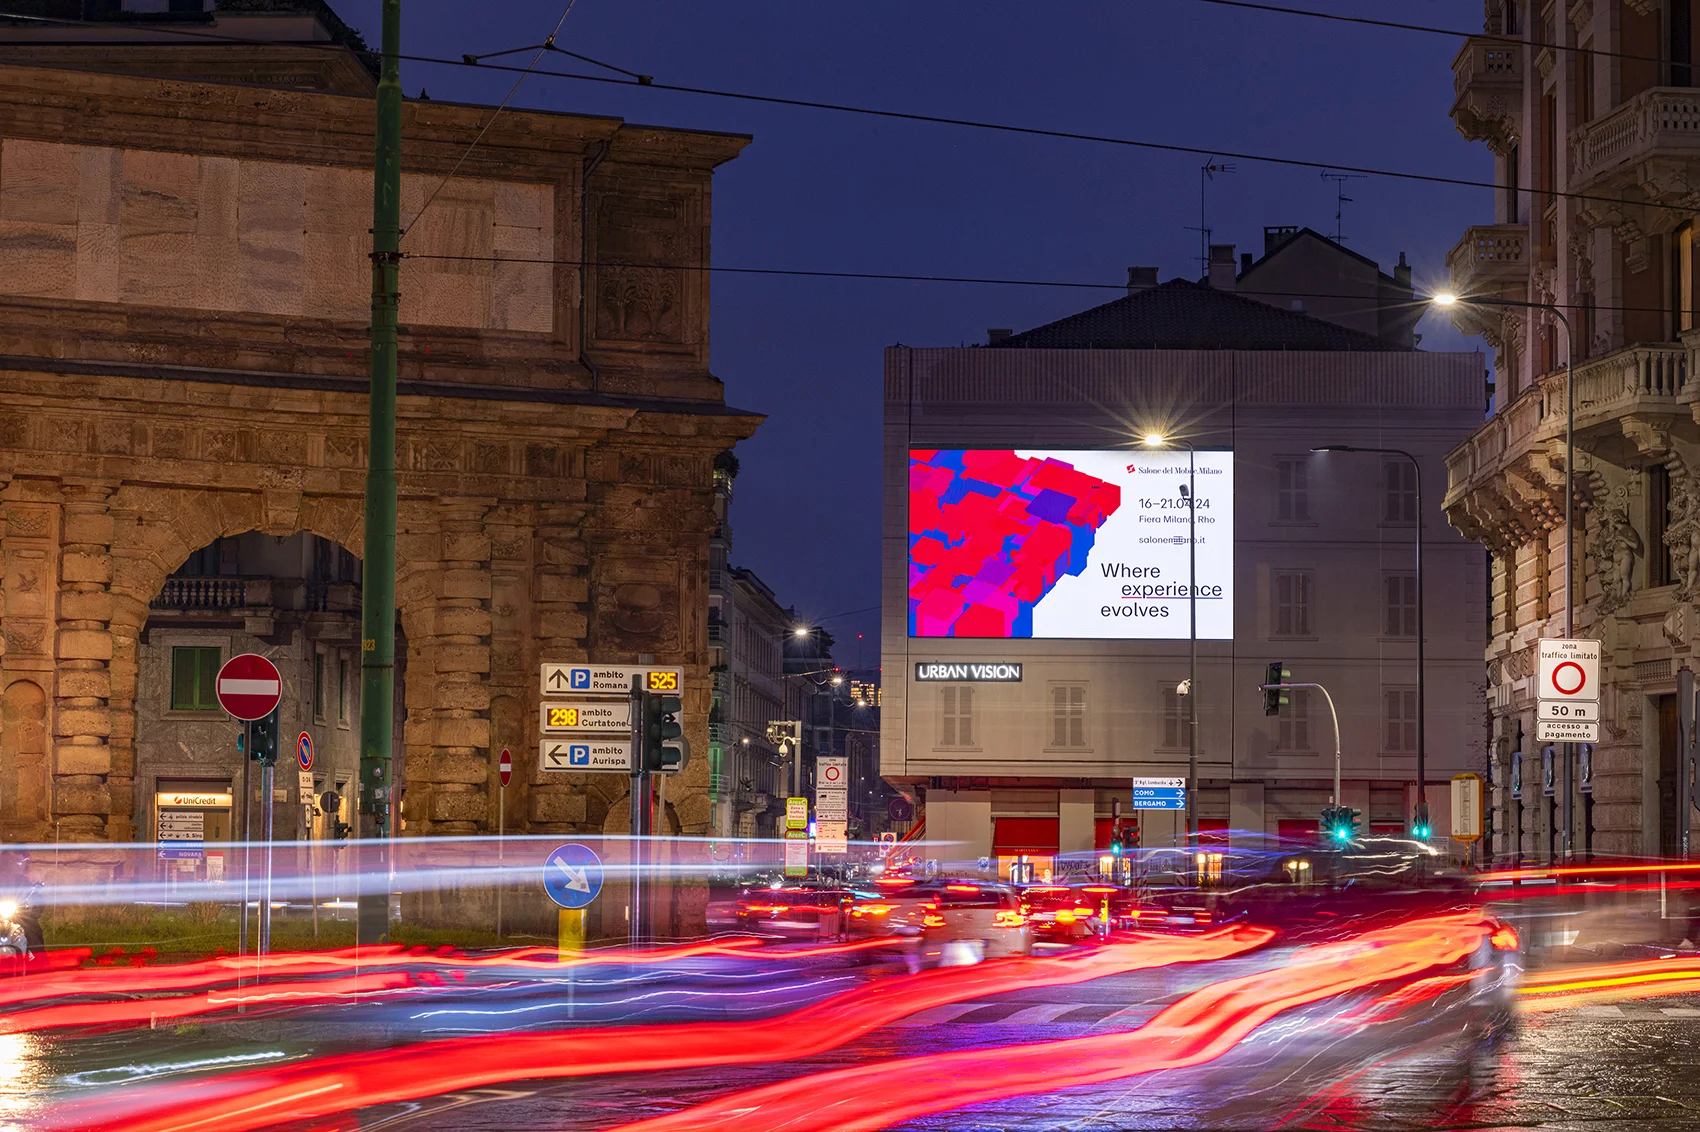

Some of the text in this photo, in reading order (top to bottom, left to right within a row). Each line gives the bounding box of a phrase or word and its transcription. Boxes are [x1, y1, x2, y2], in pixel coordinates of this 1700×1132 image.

[1138, 467, 1161, 475] Salone
[1162, 467, 1173, 475] del
[1138, 515, 1161, 523] Fiera
[1197, 515, 1216, 523] Rho
[1101, 563, 1161, 578] Where
[1121, 581, 1222, 599] experience
[1100, 602, 1169, 617] evolves
[1570, 652, 1598, 660] limitato
[593, 671, 624, 679] ambito
[919, 665, 1020, 679] URBAN VISION
[650, 672, 677, 690] 525
[1551, 705, 1586, 716] 50 m
[550, 708, 577, 726] 298
[581, 719, 627, 727] Curtatone
[1544, 731, 1591, 739] pagamento
[592, 747, 623, 755] ambito
[592, 757, 626, 766] Aurispa
[183, 797, 216, 805] UniCredit
